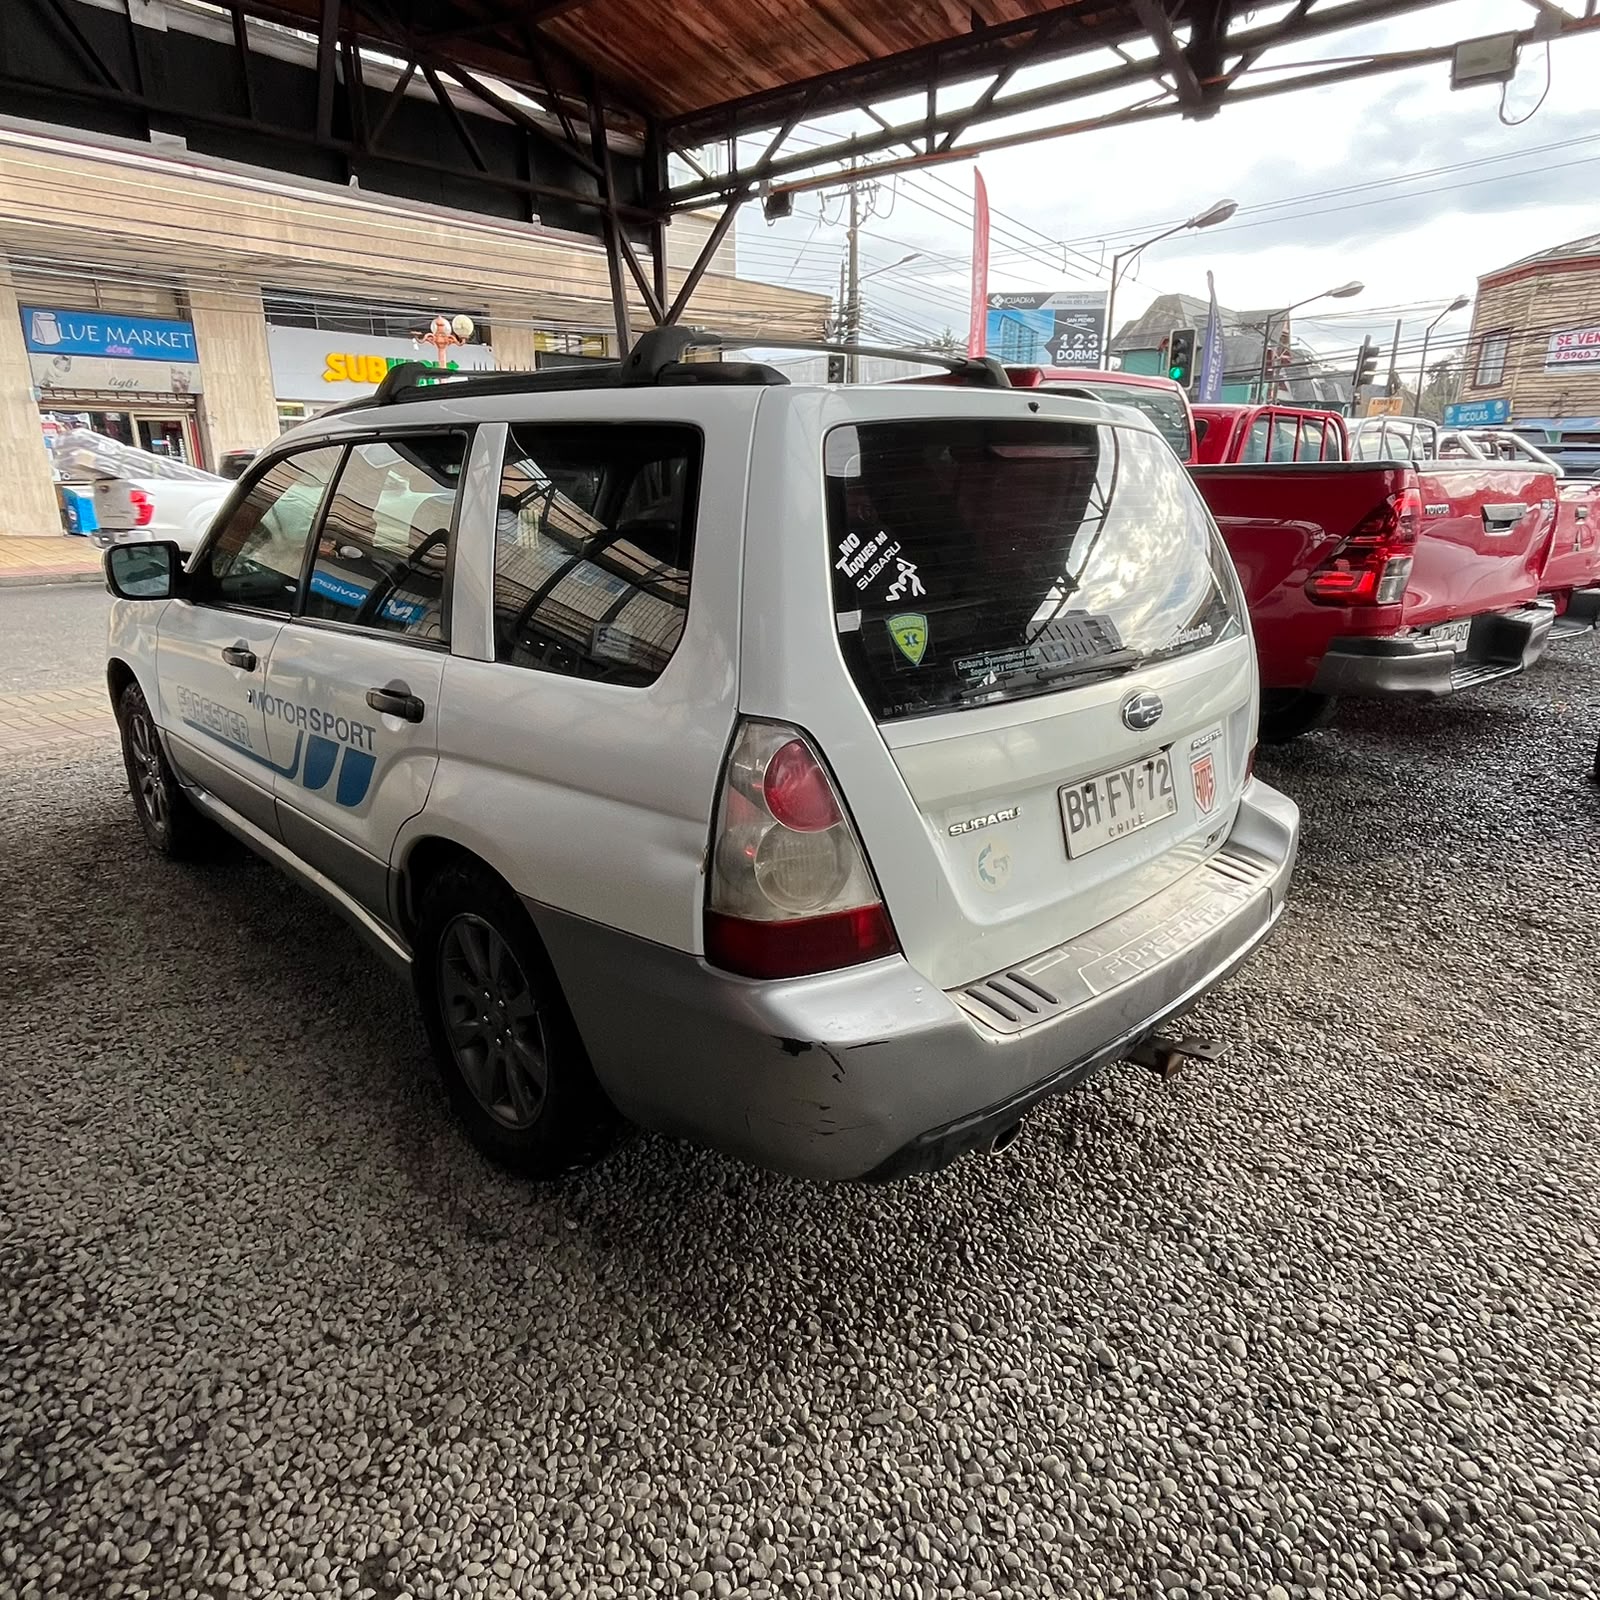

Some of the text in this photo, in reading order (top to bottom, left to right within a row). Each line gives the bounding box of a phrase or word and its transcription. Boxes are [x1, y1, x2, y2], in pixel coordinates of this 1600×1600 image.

[106, 326, 193, 349] MARKET
[1556, 334, 1573, 346] SE
[1056, 349, 1099, 361] DORMS
[1206, 357, 1218, 400] PEREZ
[1458, 409, 1489, 422] NICOLAS
[838, 532, 861, 558] NO
[874, 531, 888, 546] MI
[856, 541, 901, 591] SUBARU
[958, 659, 984, 670] Subaru
[177, 686, 253, 748] FORESTER
[252, 690, 377, 751] MOTORSPORT
[948, 806, 1021, 837] SUBARU
[1108, 812, 1145, 837] CHILE
